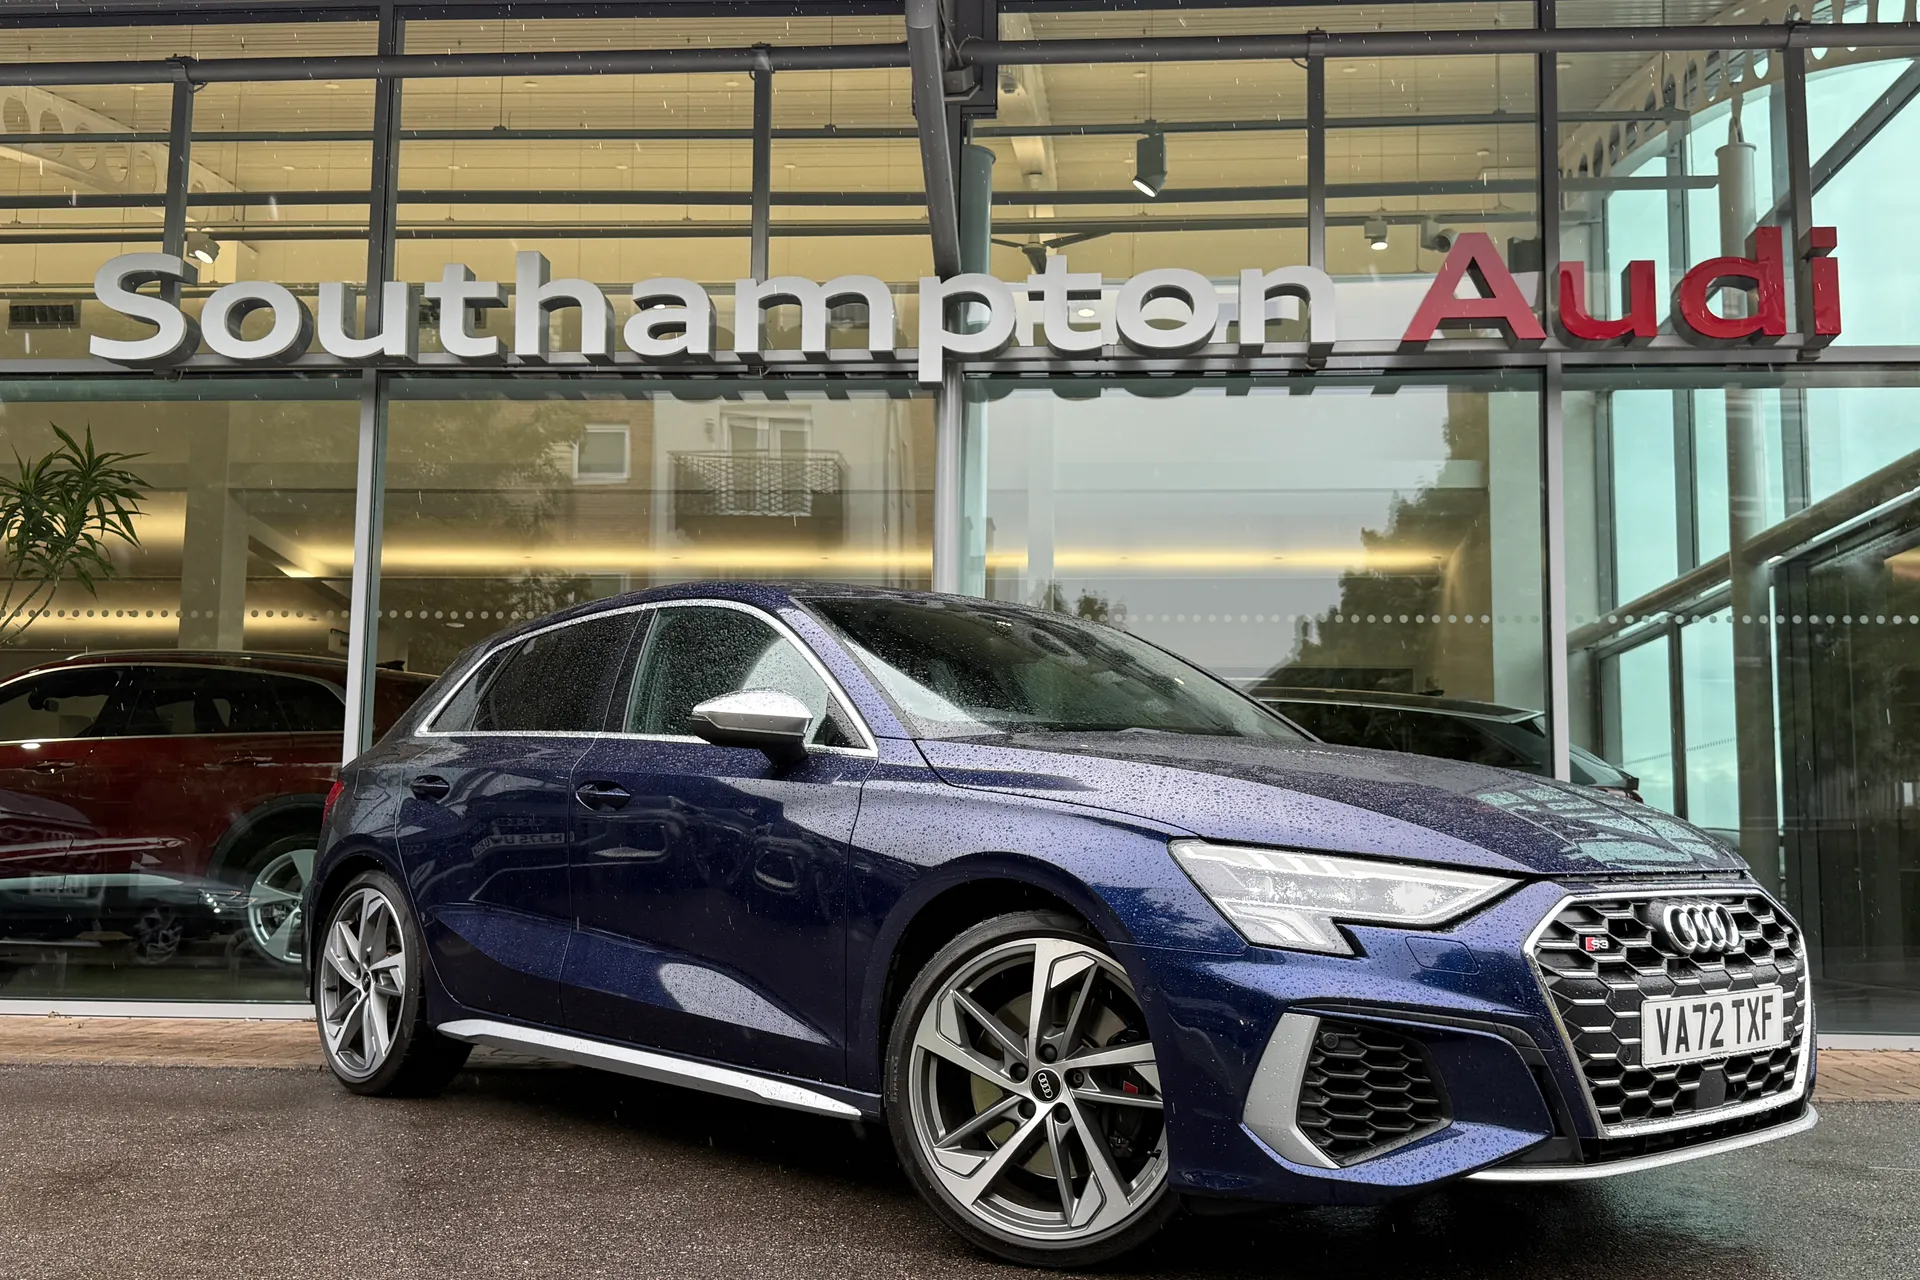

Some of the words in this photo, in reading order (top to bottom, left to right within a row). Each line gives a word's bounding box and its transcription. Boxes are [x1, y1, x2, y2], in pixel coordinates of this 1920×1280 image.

[89, 251, 1336, 384] Southampton
[1401, 226, 1842, 342] Audi
[1655, 1001, 1725, 1056] VA72
[1731, 994, 1774, 1045] TXF
